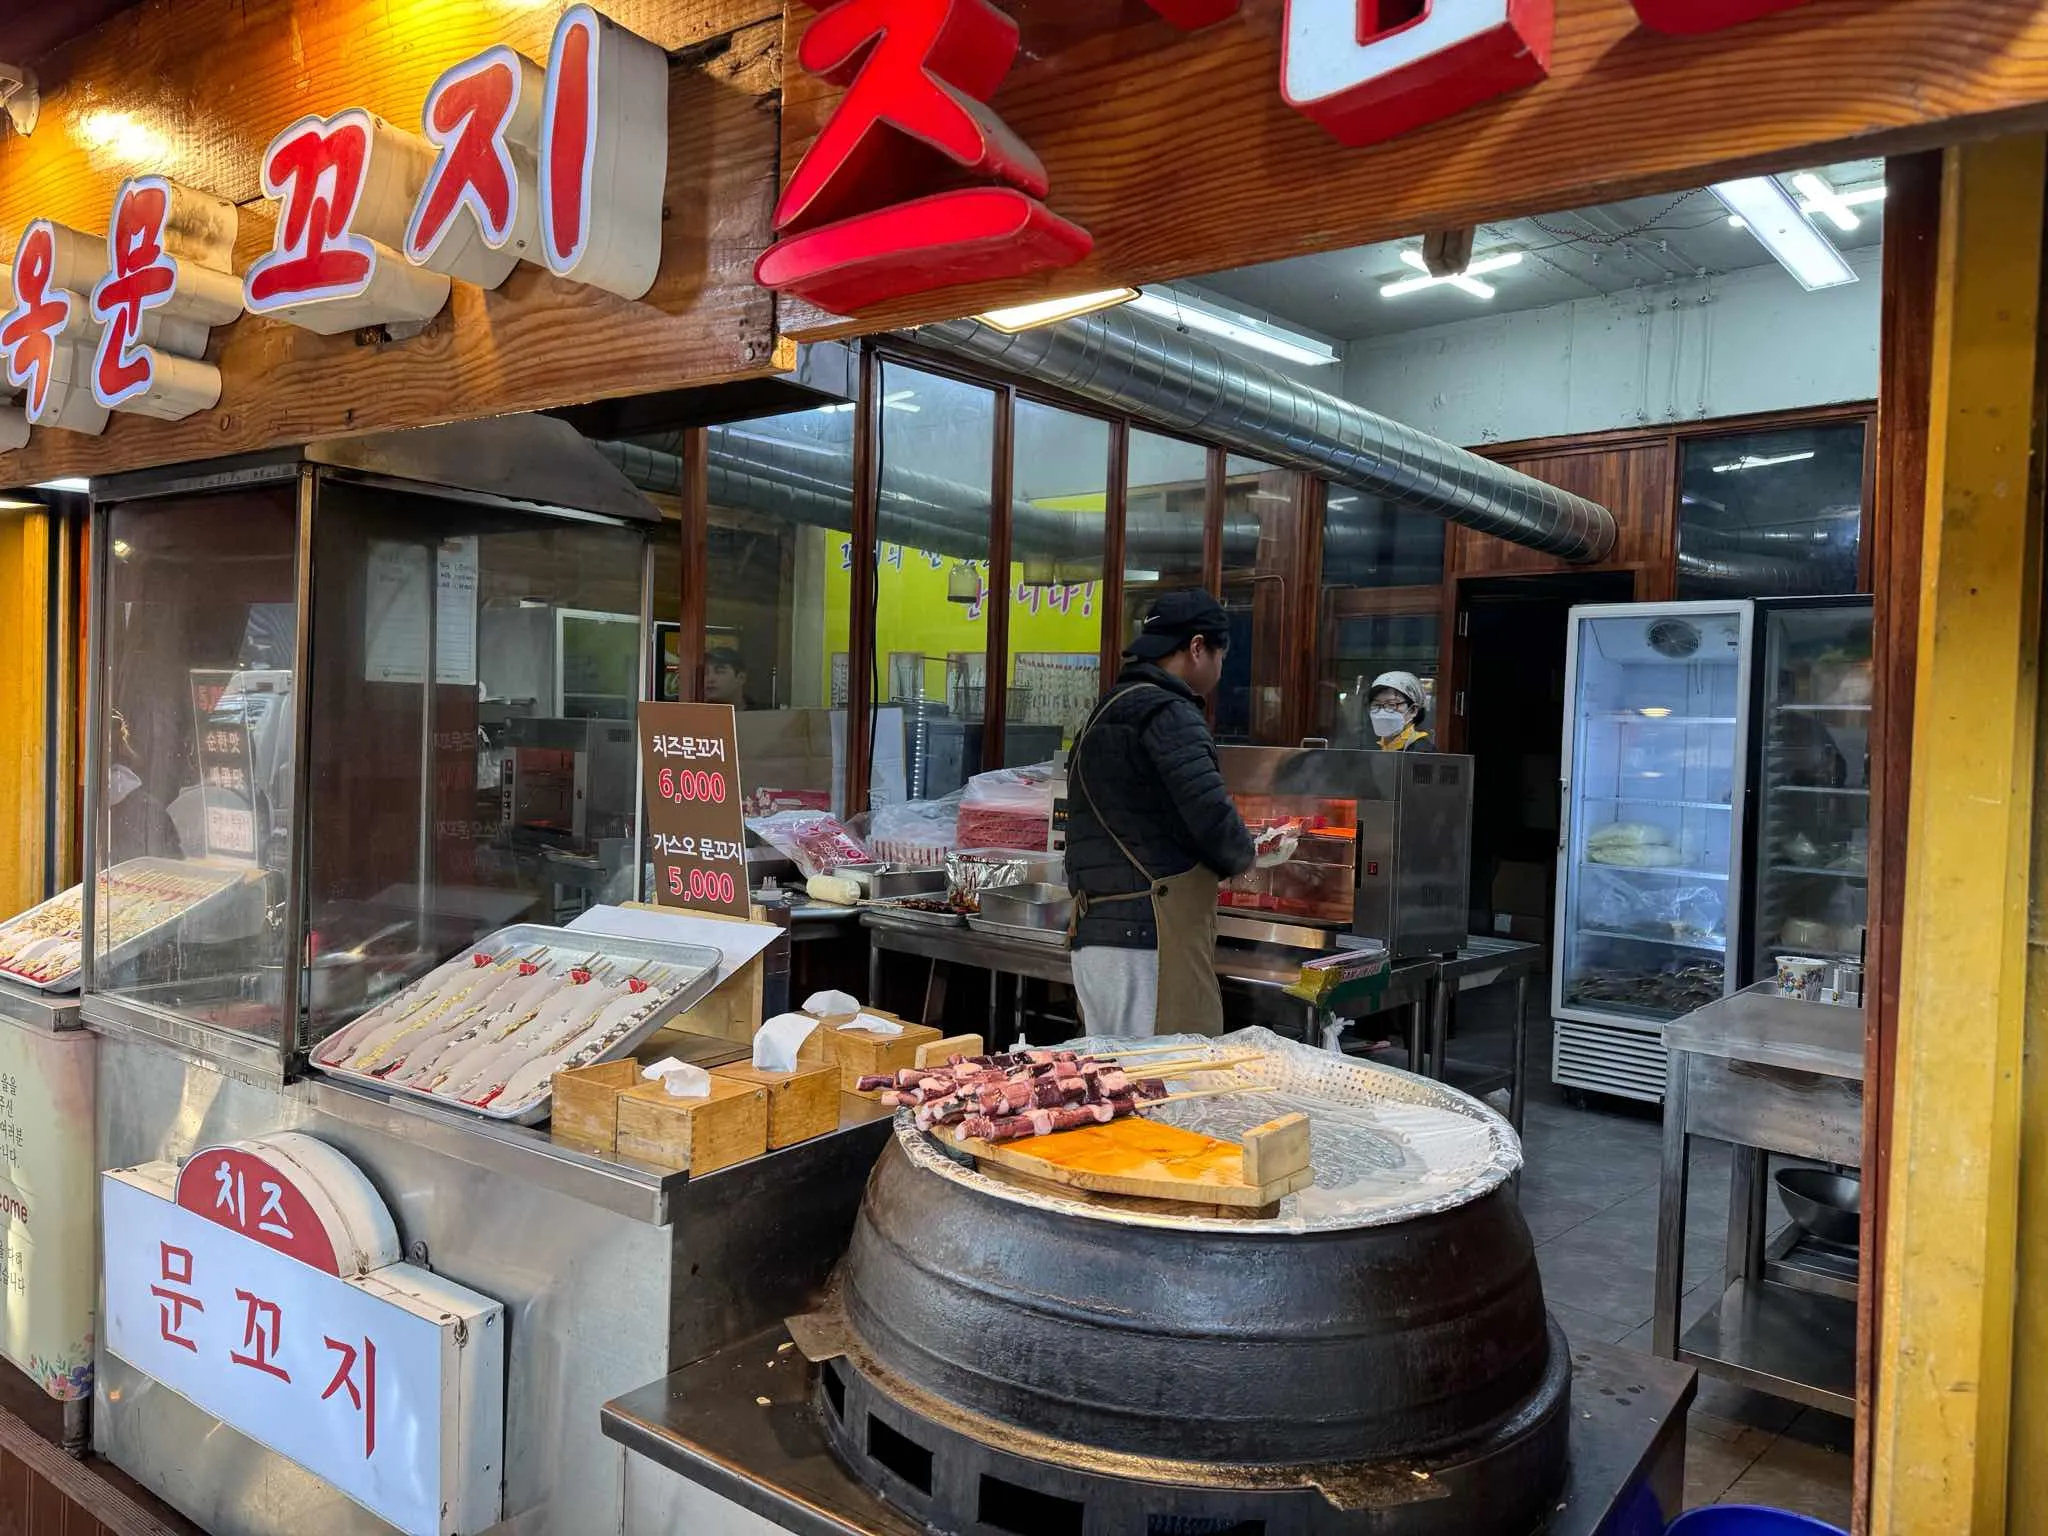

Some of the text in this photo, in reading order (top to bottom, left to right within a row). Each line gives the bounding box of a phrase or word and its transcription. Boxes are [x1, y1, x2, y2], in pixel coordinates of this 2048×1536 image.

[652, 734, 726, 763] 치즈문꼬지
[658, 767, 726, 804] 6,000
[653, 832, 744, 866] 가스오 문꼬지
[667, 865, 735, 904] 5,000
[214, 1160, 295, 1240] 치즈
[150, 1240, 376, 1460] 문꼬지
